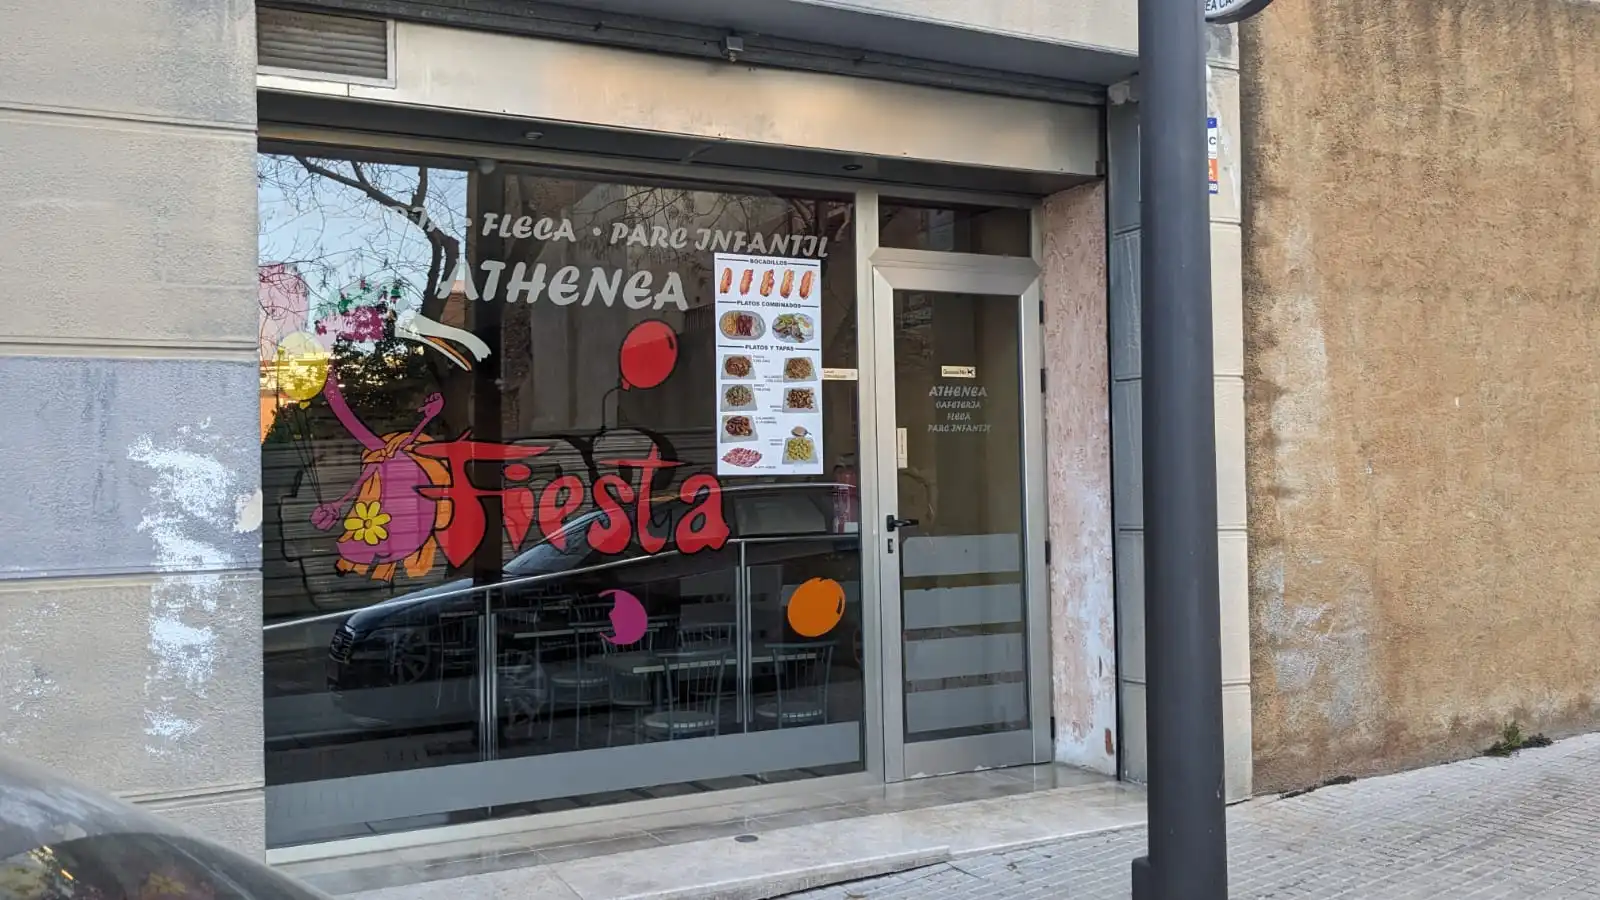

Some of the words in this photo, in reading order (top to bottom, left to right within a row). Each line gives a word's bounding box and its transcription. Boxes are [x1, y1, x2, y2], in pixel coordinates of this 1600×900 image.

[481, 212, 577, 242] FLECA
[610, 222, 688, 249] PARC
[694, 228, 829, 258] INFANTIL
[435, 258, 690, 312] ATHENEA
[928, 385, 988, 397] ATHENEA
[936, 401, 981, 409] CAFETERIA
[927, 424, 949, 433] PARC
[411, 430, 731, 569] Fiesta
